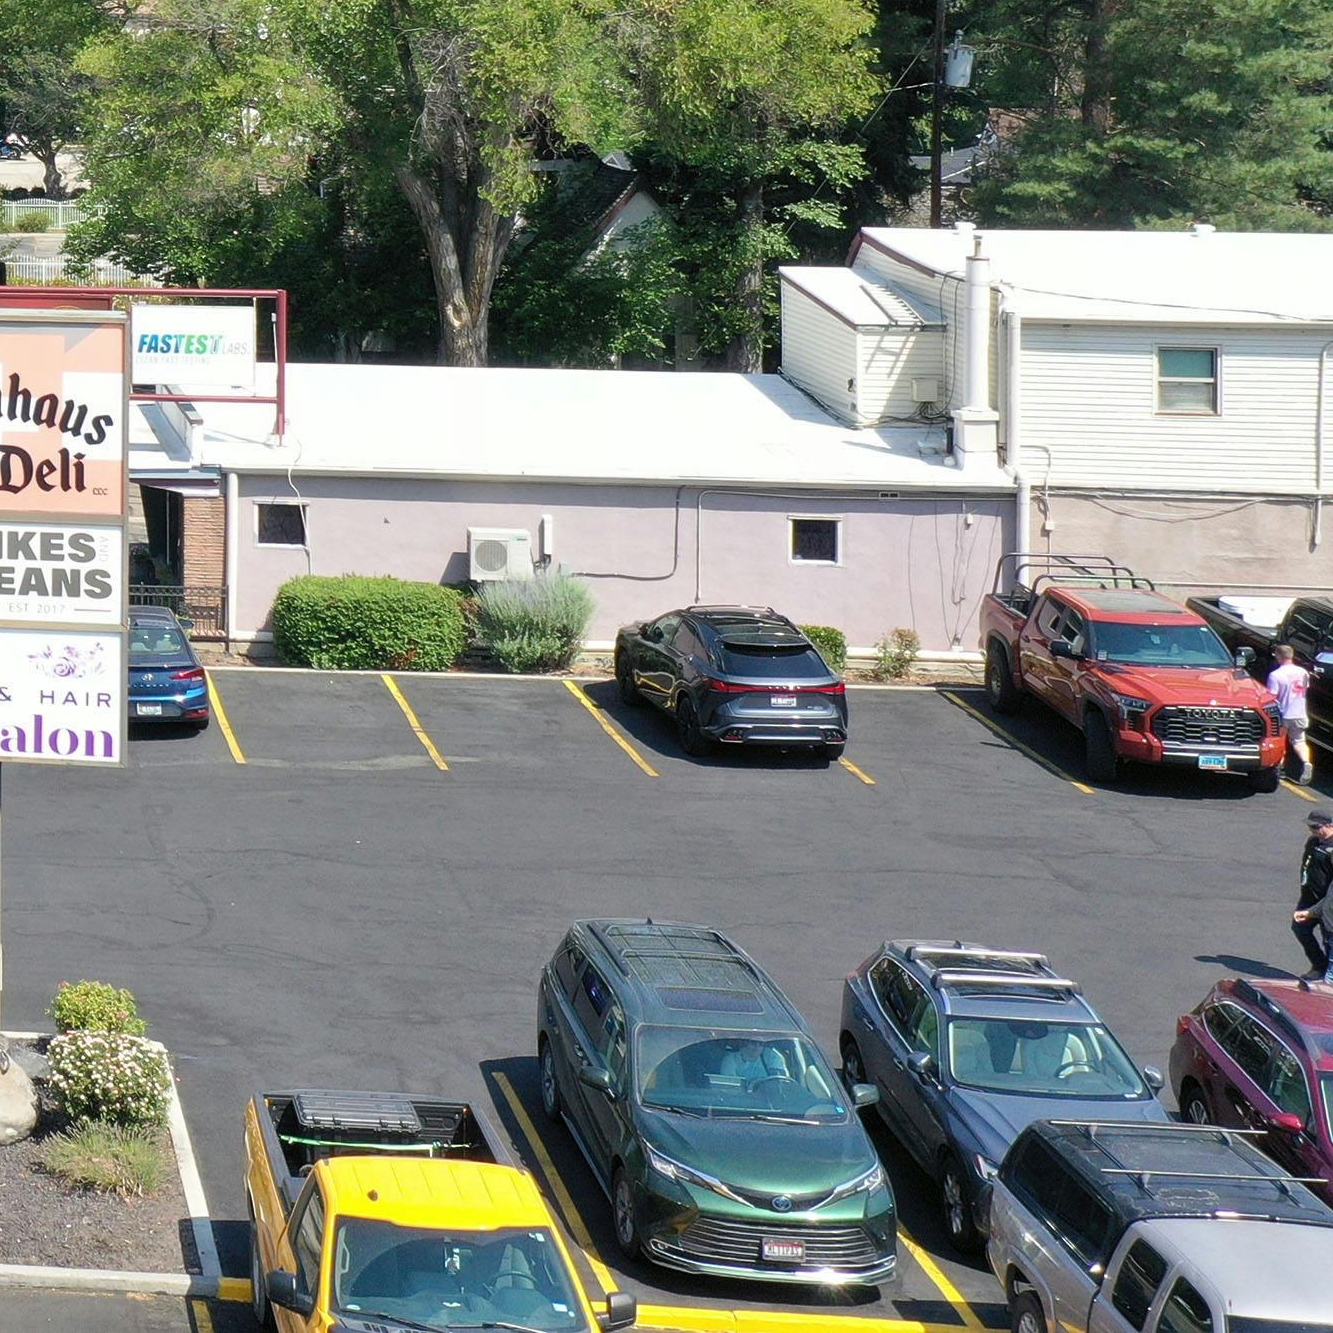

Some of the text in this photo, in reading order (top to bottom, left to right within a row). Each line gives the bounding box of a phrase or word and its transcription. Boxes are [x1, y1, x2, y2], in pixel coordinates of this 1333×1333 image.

[137, 333, 222, 355] FASTEST
[99, 535, 110, 563] AND
[8, 602, 66, 615] EST 2017
[39, 689, 113, 708] HAIR
[1185, 709, 1238, 720] TOYOTA
